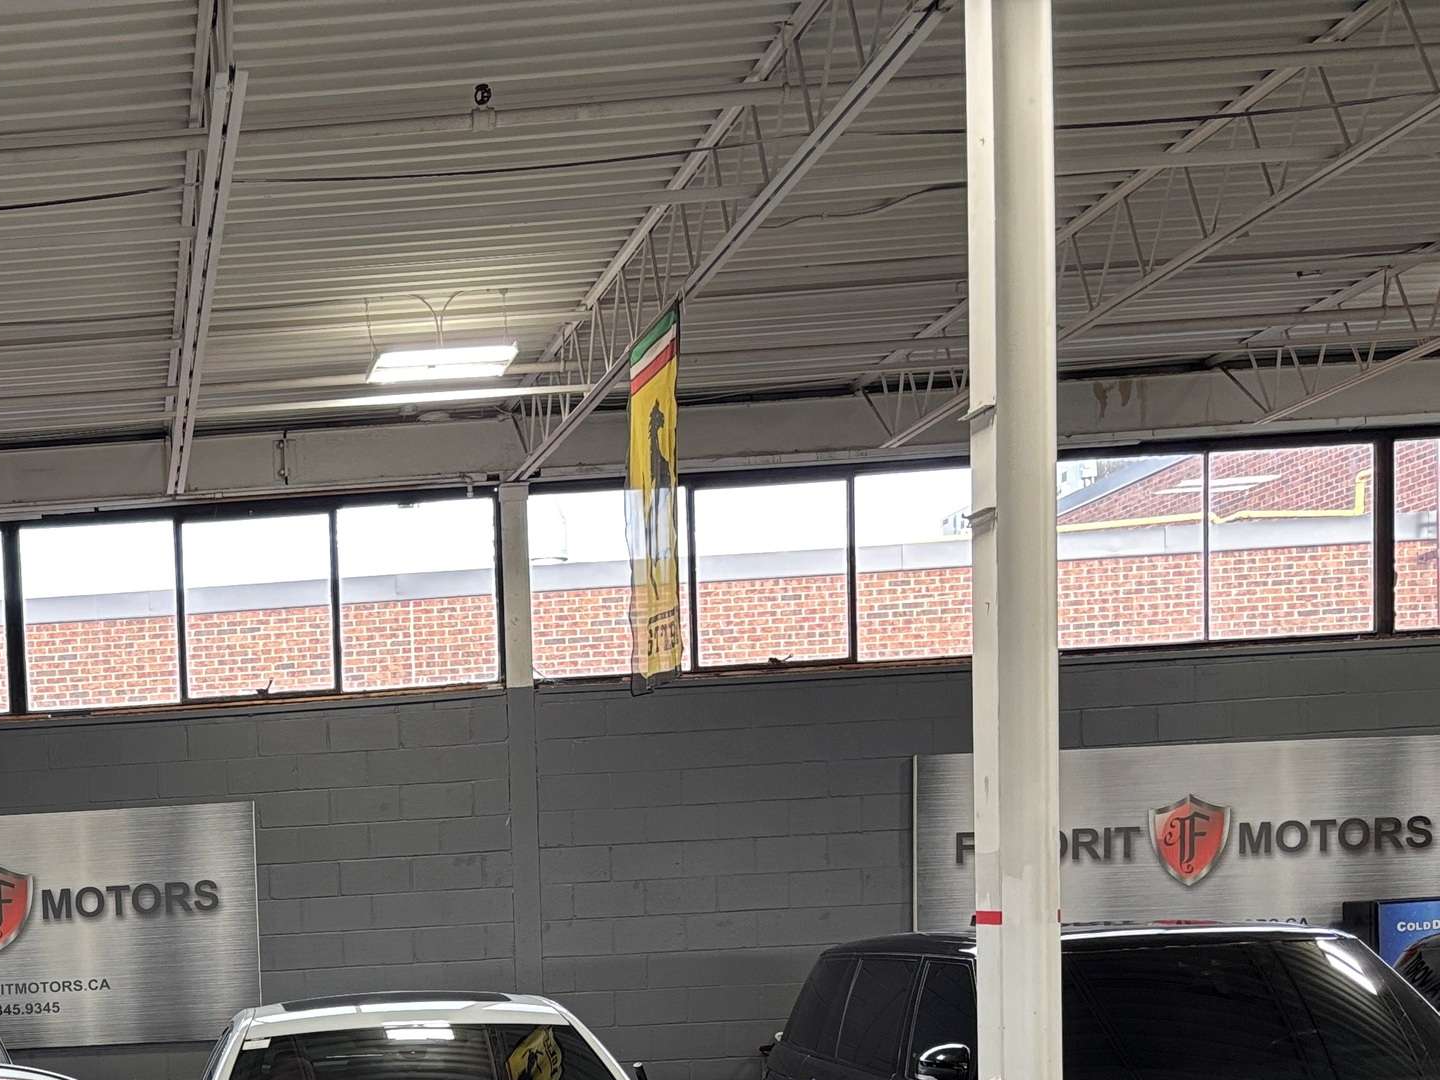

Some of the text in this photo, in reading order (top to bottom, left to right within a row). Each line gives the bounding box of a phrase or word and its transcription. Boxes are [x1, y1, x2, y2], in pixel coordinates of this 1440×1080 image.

[956, 826, 1140, 864] FRIT
[1239, 815, 1433, 854] MOTORS
[41, 879, 219, 920] MOTORS
